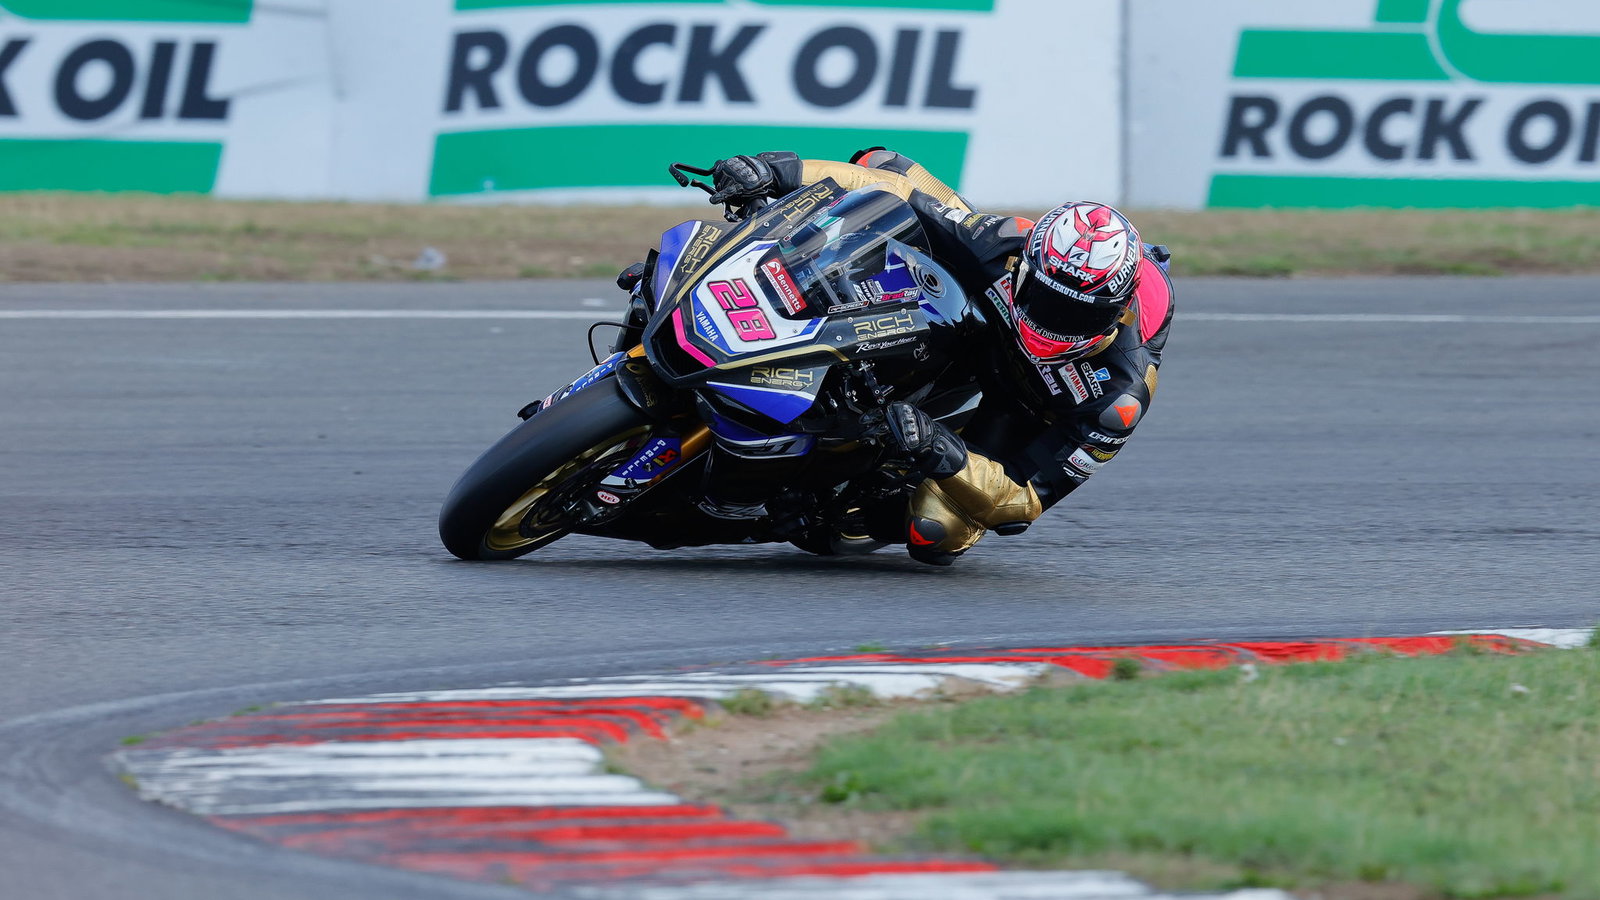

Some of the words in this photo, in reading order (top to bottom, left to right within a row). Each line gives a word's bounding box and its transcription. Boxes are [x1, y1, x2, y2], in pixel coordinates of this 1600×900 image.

[55, 40, 228, 120] OIL
[447, 25, 762, 111] ROCK
[795, 27, 973, 107] OIL
[1223, 97, 1479, 159] ROCK
[784, 186, 834, 222] RICH
[681, 224, 712, 273] ENERGY
[685, 226, 722, 273] RICH
[1108, 239, 1137, 293] BURNELL
[1034, 269, 1096, 304] WWW.ESKUTA.COM
[1048, 255, 1097, 284] SHARK
[707, 277, 777, 342] 28
[777, 273, 802, 311] Bennetts
[696, 311, 720, 342] YAMAHA
[853, 313, 913, 334] RICH
[857, 325, 915, 341] ENERGY
[1016, 304, 1037, 331] WATCHES
[1042, 330, 1085, 343] DISTINCTION
[750, 376, 814, 388] ENERGY
[751, 366, 813, 382] RICH
[1069, 370, 1088, 400] YAMAHA
[1081, 362, 1103, 399] SHARK
[621, 439, 667, 477] PIRELLI
